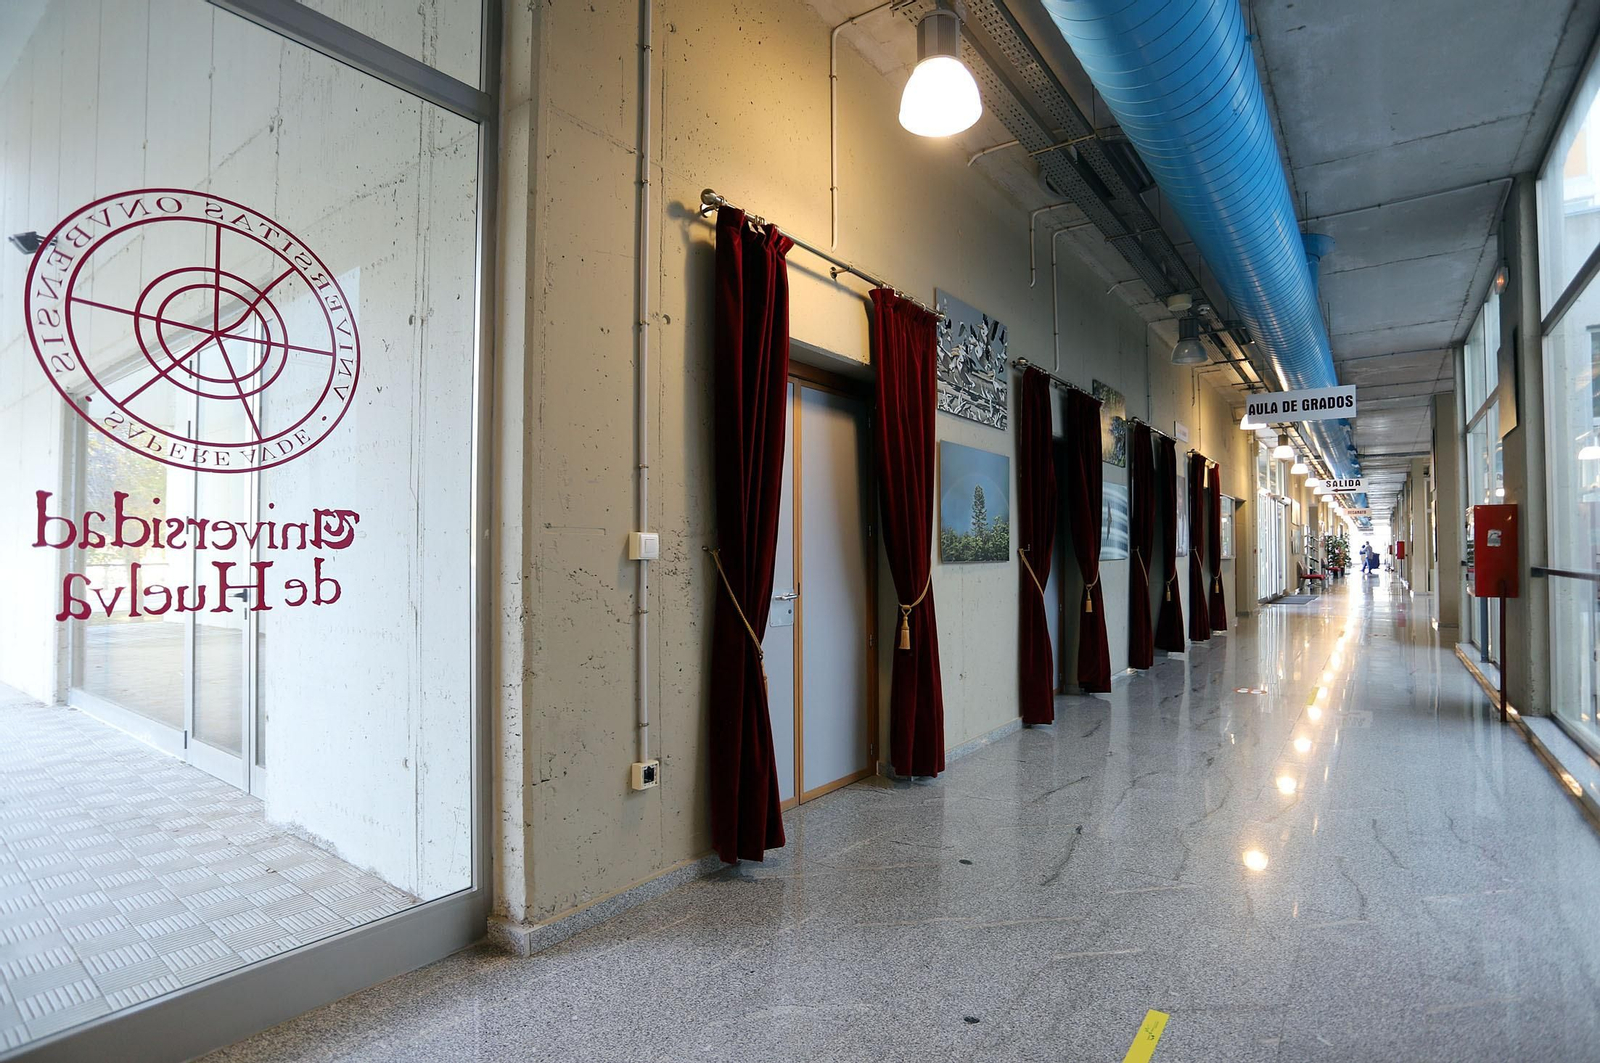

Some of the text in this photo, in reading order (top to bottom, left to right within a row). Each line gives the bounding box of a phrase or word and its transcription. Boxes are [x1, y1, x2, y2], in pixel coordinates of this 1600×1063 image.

[1248, 395, 1353, 416] AULA DE GRADOS
[1326, 480, 1361, 488] SALIDA
